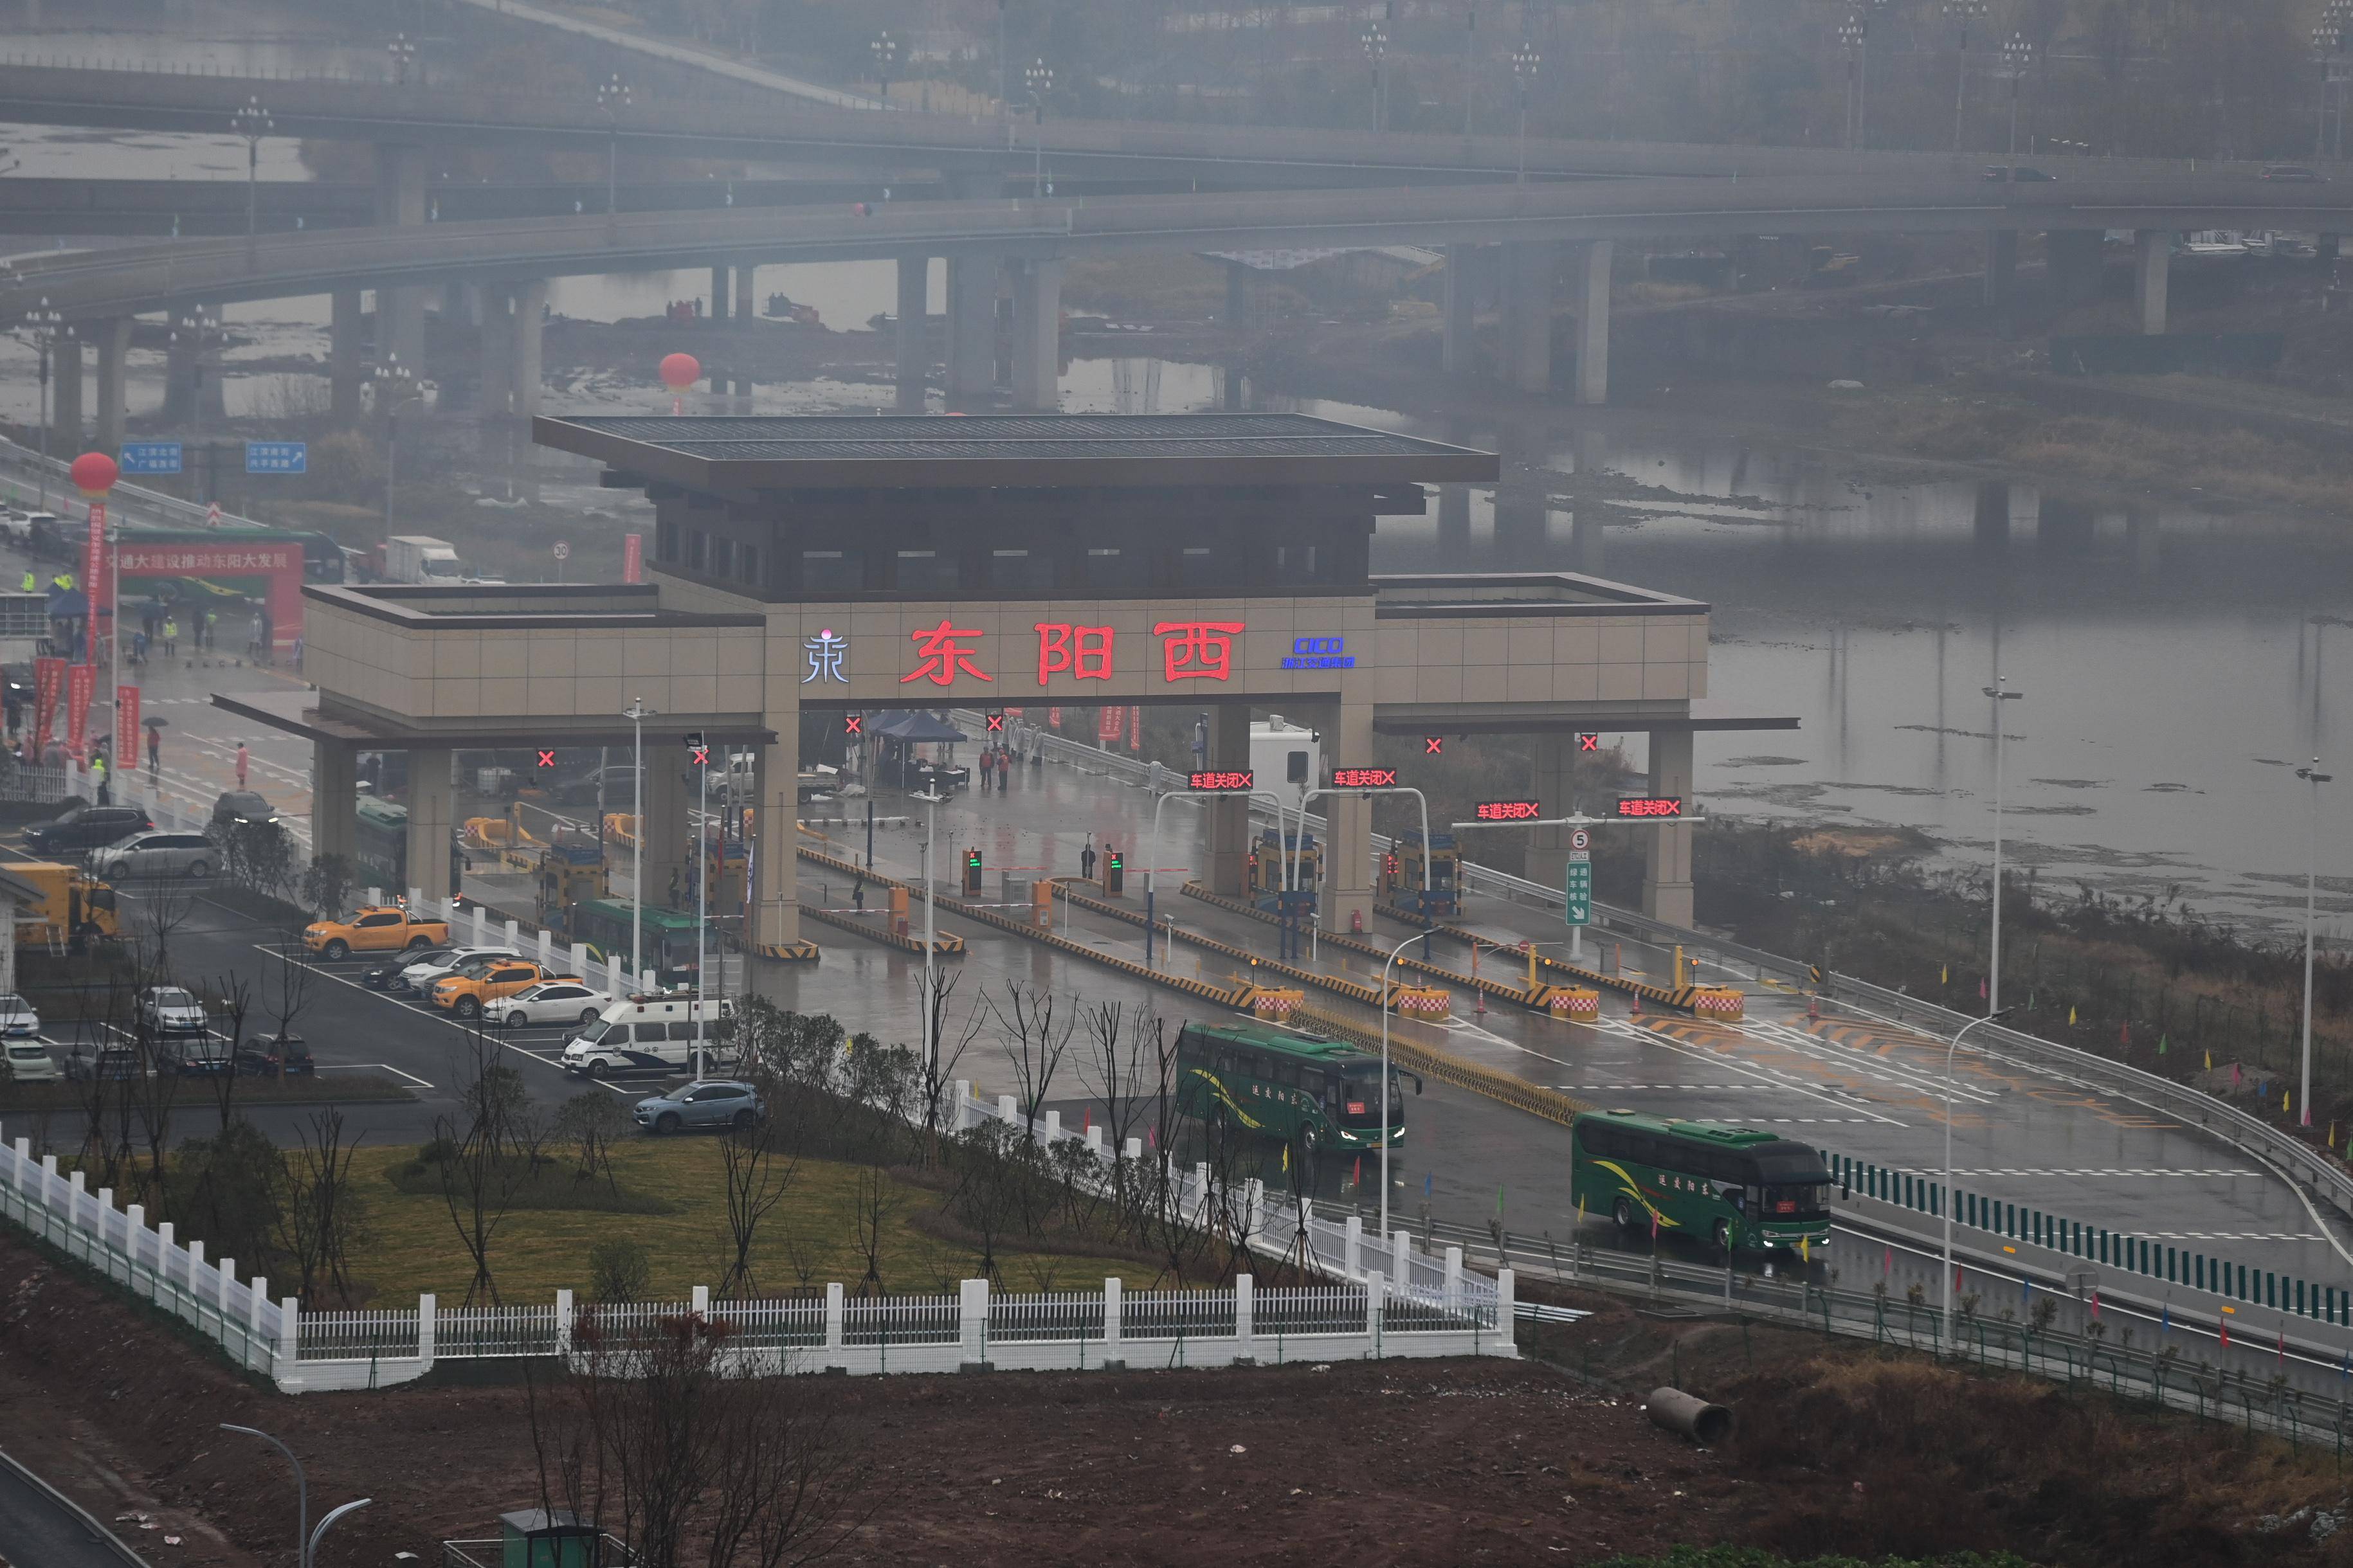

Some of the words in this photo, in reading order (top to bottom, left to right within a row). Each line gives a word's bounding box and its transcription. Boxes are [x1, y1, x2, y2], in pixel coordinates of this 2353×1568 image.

[900, 620, 1245, 685] 东阳西
[1294, 637, 1343, 654] CICO
[1282, 656, 1356, 669] 浙江交通集团
[1190, 773, 1239, 788] 车道关闭
[1335, 770, 1383, 786] 车道关闭
[1478, 803, 1527, 819] 车道关闭
[1619, 800, 1669, 815] 车道关闭
[1577, 835, 1585, 846] 5
